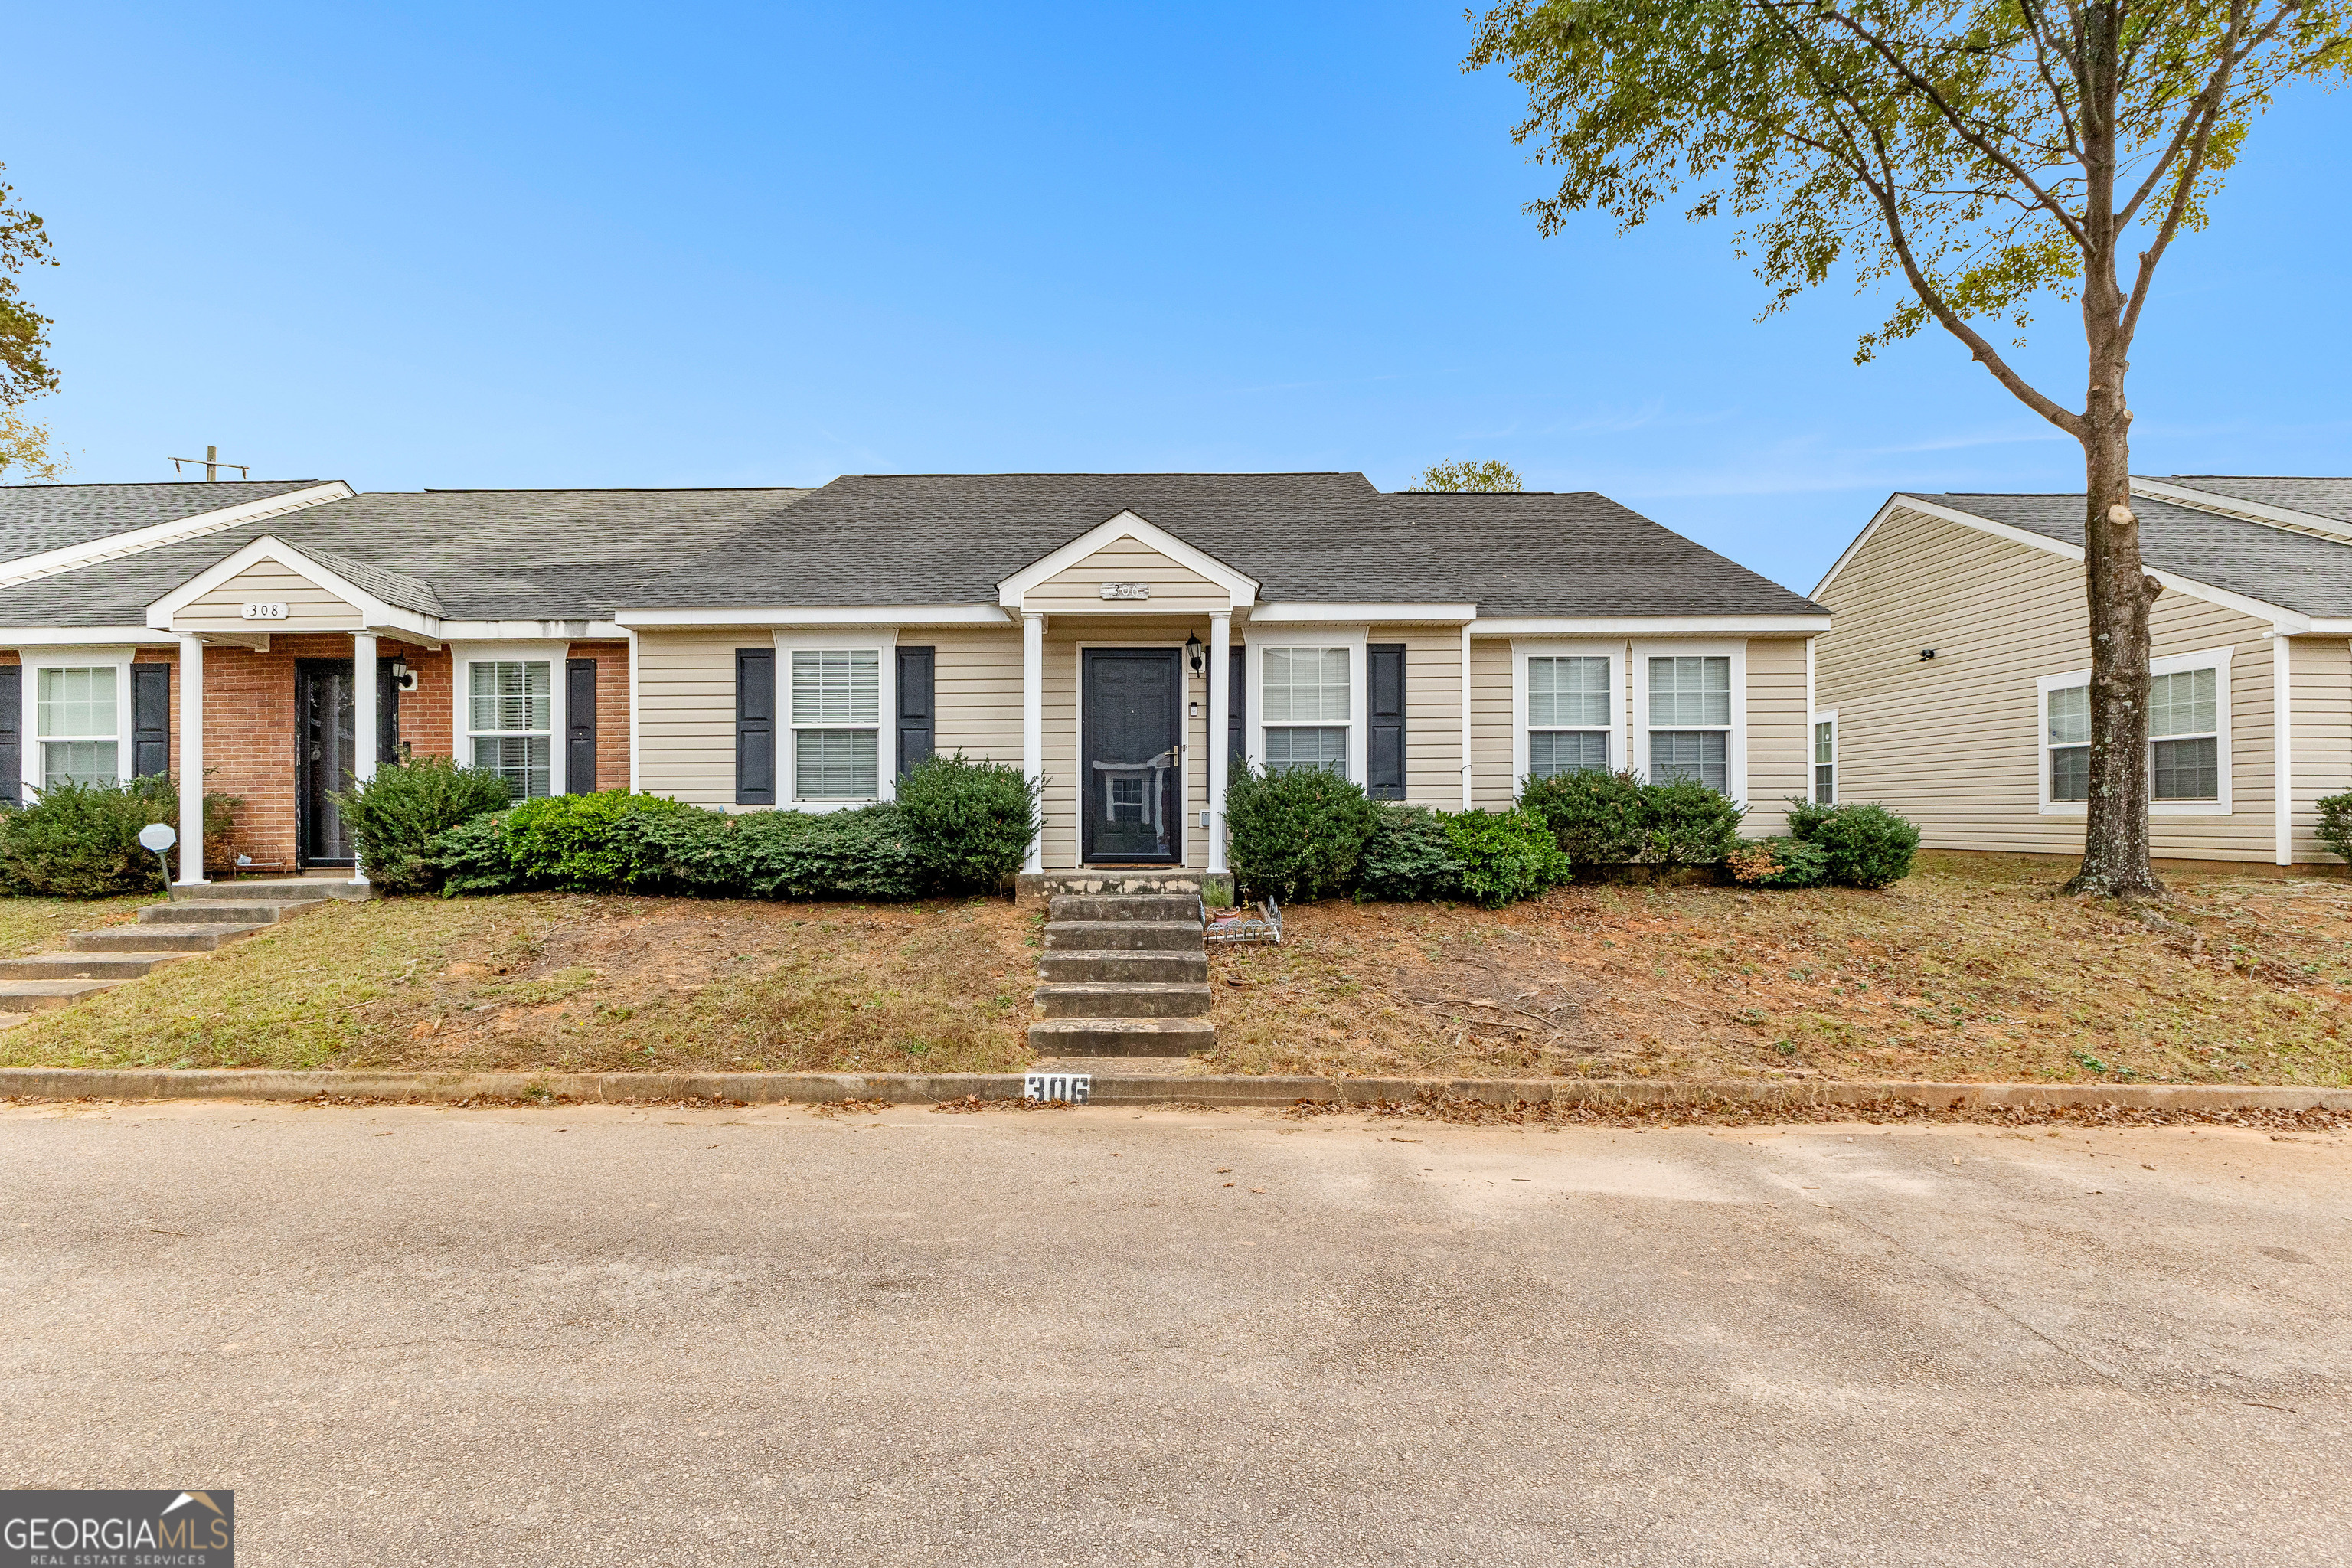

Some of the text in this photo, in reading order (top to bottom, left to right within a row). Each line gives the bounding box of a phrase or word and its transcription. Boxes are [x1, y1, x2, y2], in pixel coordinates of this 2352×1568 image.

[1112, 584, 1139, 596] 306
[250, 604, 279, 616] 308
[1028, 1076, 1088, 1104] 306
